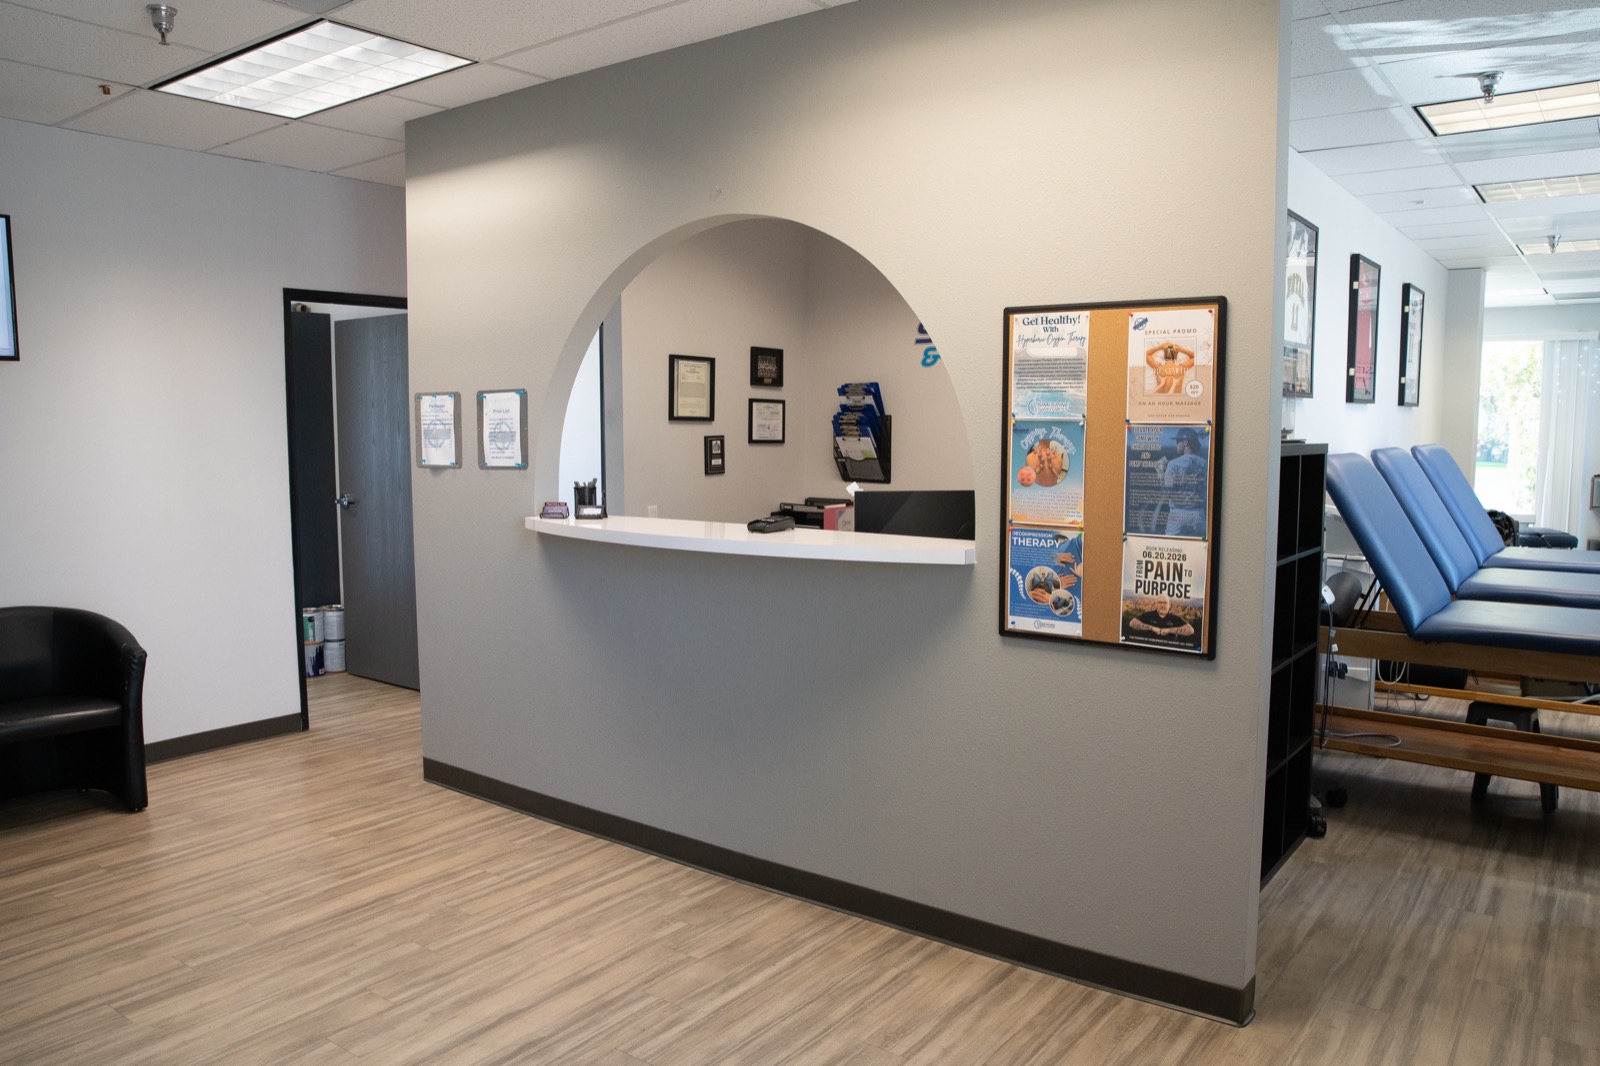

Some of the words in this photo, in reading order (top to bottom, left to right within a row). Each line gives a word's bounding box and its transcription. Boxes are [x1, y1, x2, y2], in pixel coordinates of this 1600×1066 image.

[1022, 317, 1038, 326] Get
[1040, 315, 1081, 325] Healthy!
[1047, 334, 1066, 348] Oxygen
[1067, 331, 1086, 347] Therapy
[921, 346, 941, 367] &
[1049, 426, 1077, 455] Therapy
[1012, 537, 1061, 549] THERAPY
[1142, 551, 1187, 562] 06.20.2026
[1144, 560, 1183, 582] PAIN
[1184, 569, 1192, 577] TO
[1135, 579, 1191, 599] PURPOSE
